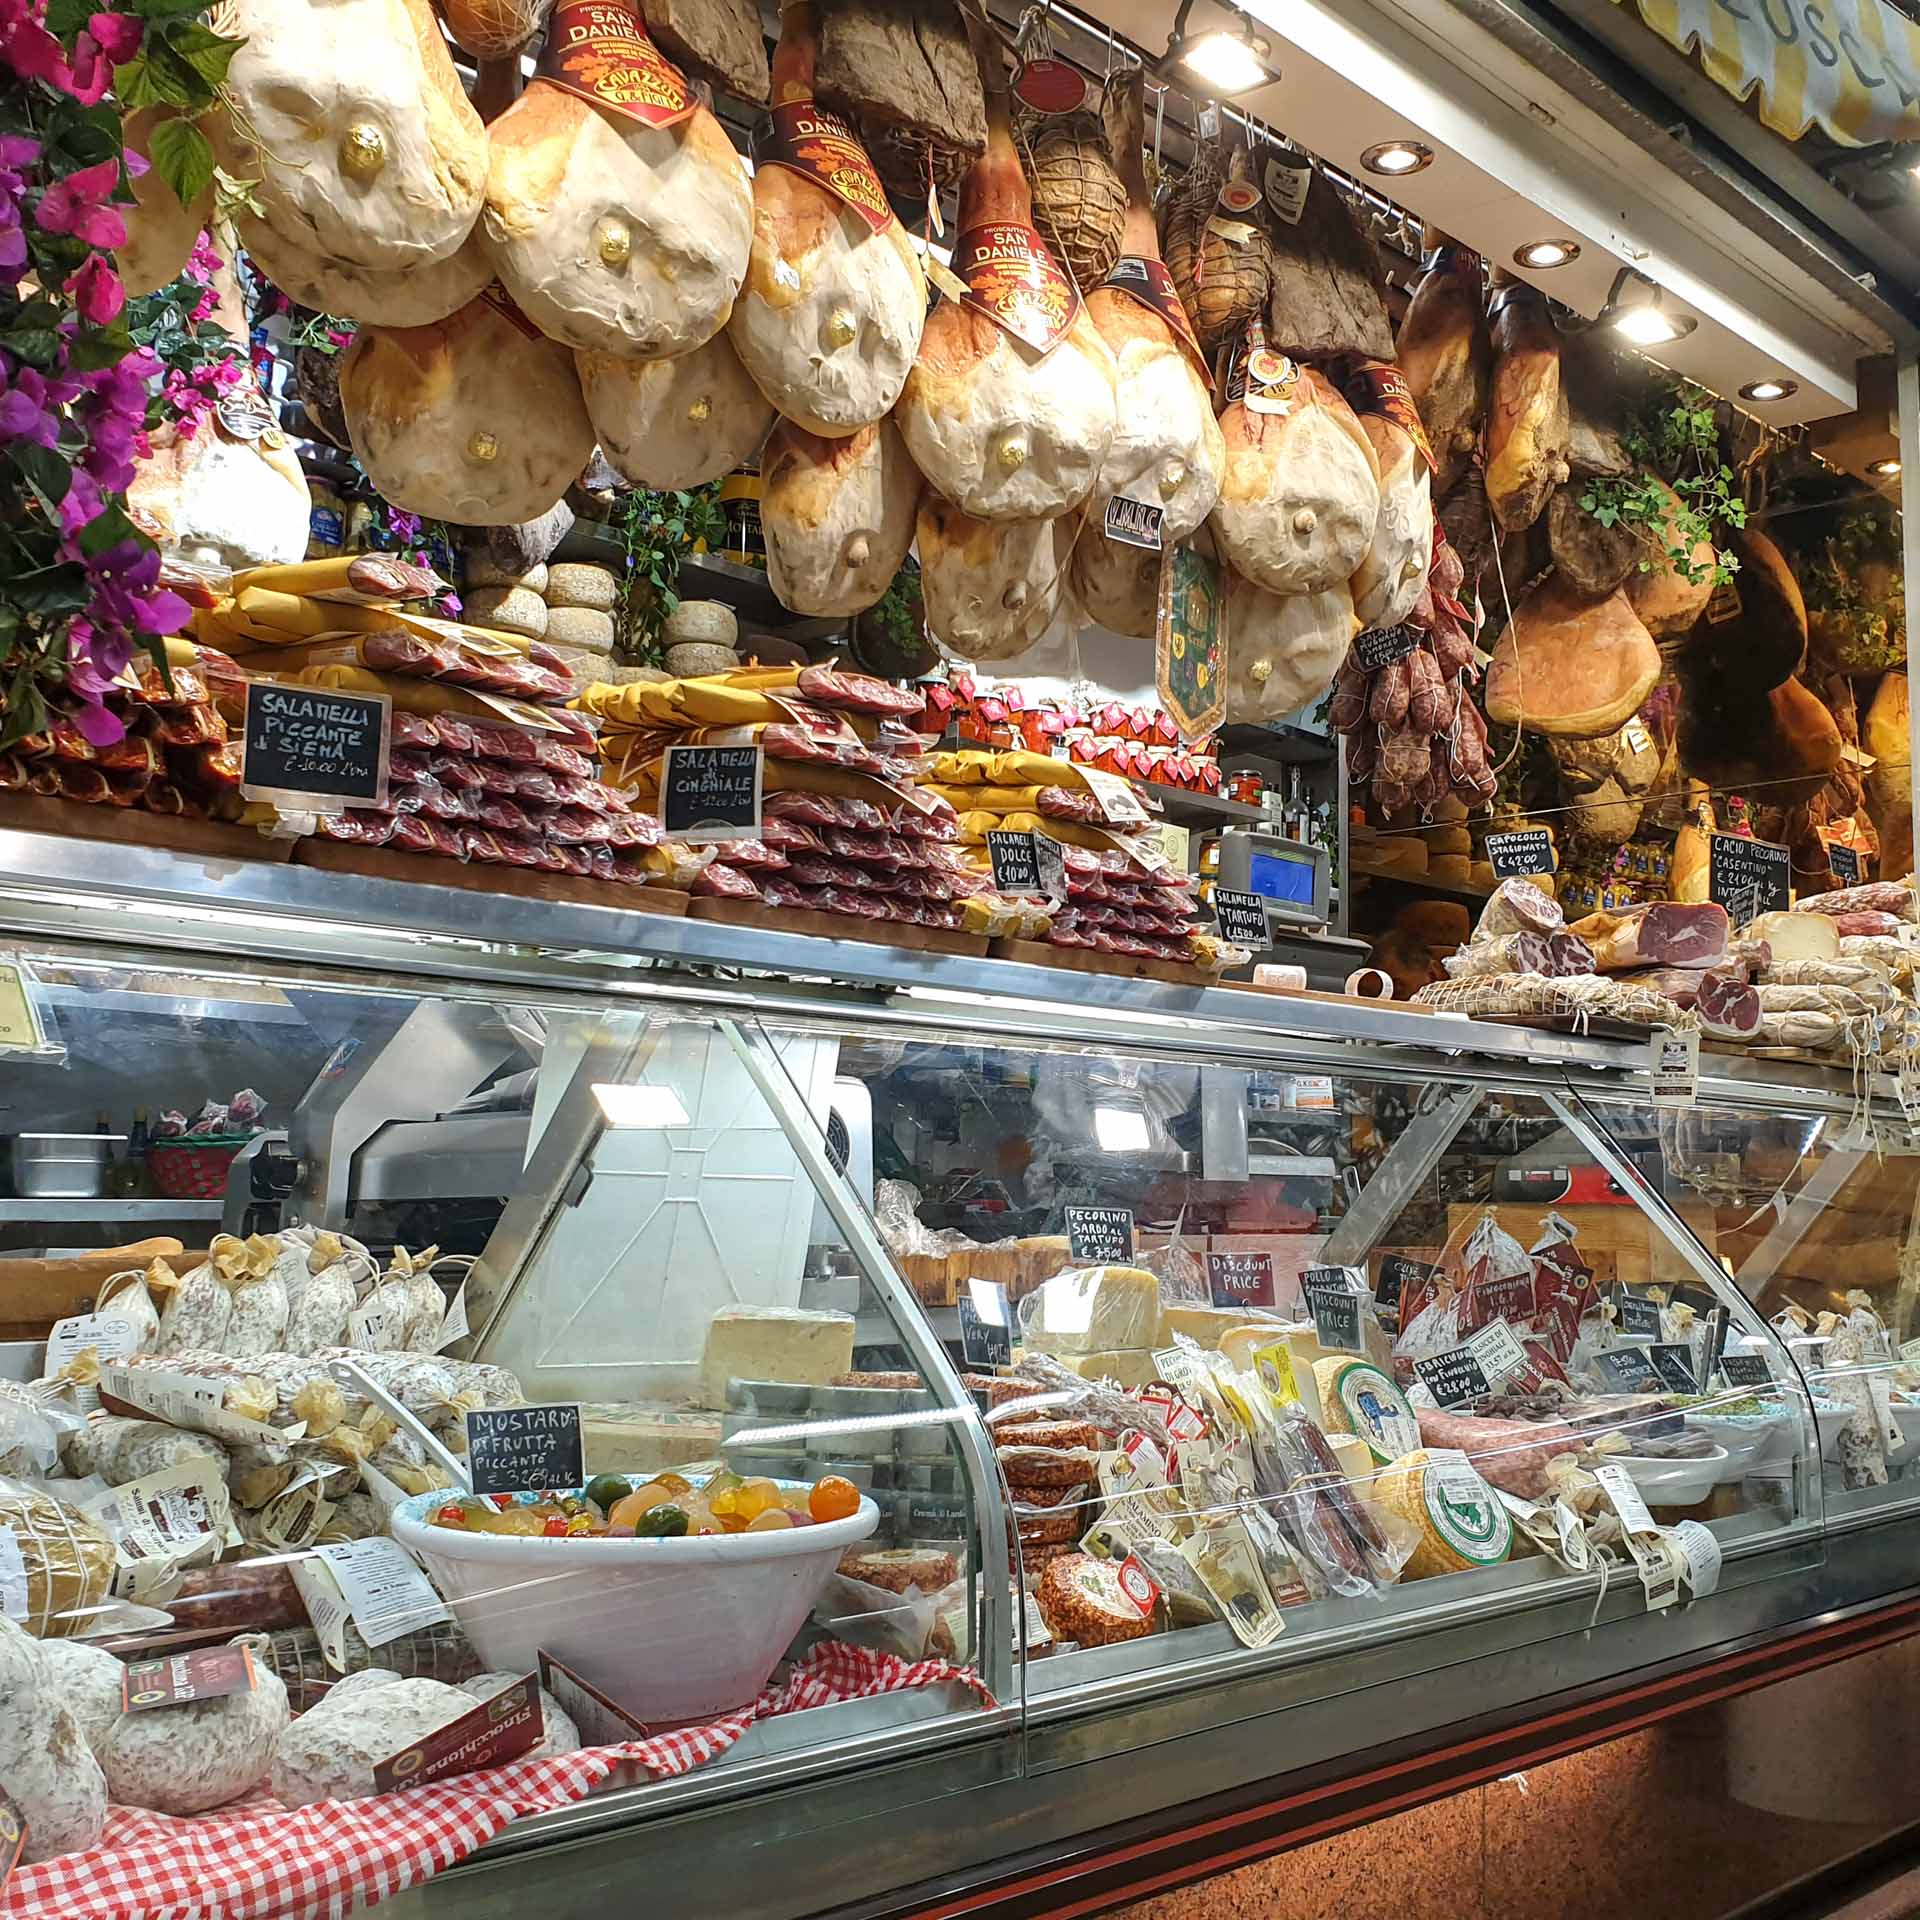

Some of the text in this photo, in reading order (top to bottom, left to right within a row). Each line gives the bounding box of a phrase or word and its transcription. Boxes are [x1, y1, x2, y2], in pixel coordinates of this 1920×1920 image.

[591, 11, 633, 27] SAN
[568, 25, 652, 44] DANIEL
[993, 232, 1028, 246] SAN
[975, 246, 1046, 261] DANIELE
[261, 693, 368, 726] SALAMELLI
[277, 737, 344, 760] SIENA
[676, 776, 753, 792] CINGHIALE
[1489, 832, 1546, 845] CAPOCOLLO
[1000, 848, 1032, 863] DOLCE
[1492, 843, 1547, 855] STAGIONATO
[1714, 837, 1788, 863] CACIO PECORINO
[1216, 890, 1261, 908] SALAMELLA
[1226, 909, 1263, 926] TARTUFO
[1069, 1209, 1127, 1224] PECORINO
[1072, 1222, 1107, 1235] SARDO
[1078, 1235, 1124, 1245] TARTUFO
[1212, 1256, 1271, 1272] DISCOUNT
[1223, 1274, 1261, 1290] PRICE
[1304, 1270, 1331, 1282] POLLO
[1315, 1293, 1356, 1310] DISCOUNT
[1320, 1311, 1350, 1328] PRICE
[476, 1408, 577, 1436] MOSTARDA
[493, 1434, 557, 1454] FRUTTA
[1127, 1494, 1162, 1538] SALAMINO
[425, 1704, 533, 1775] Finocchiona
